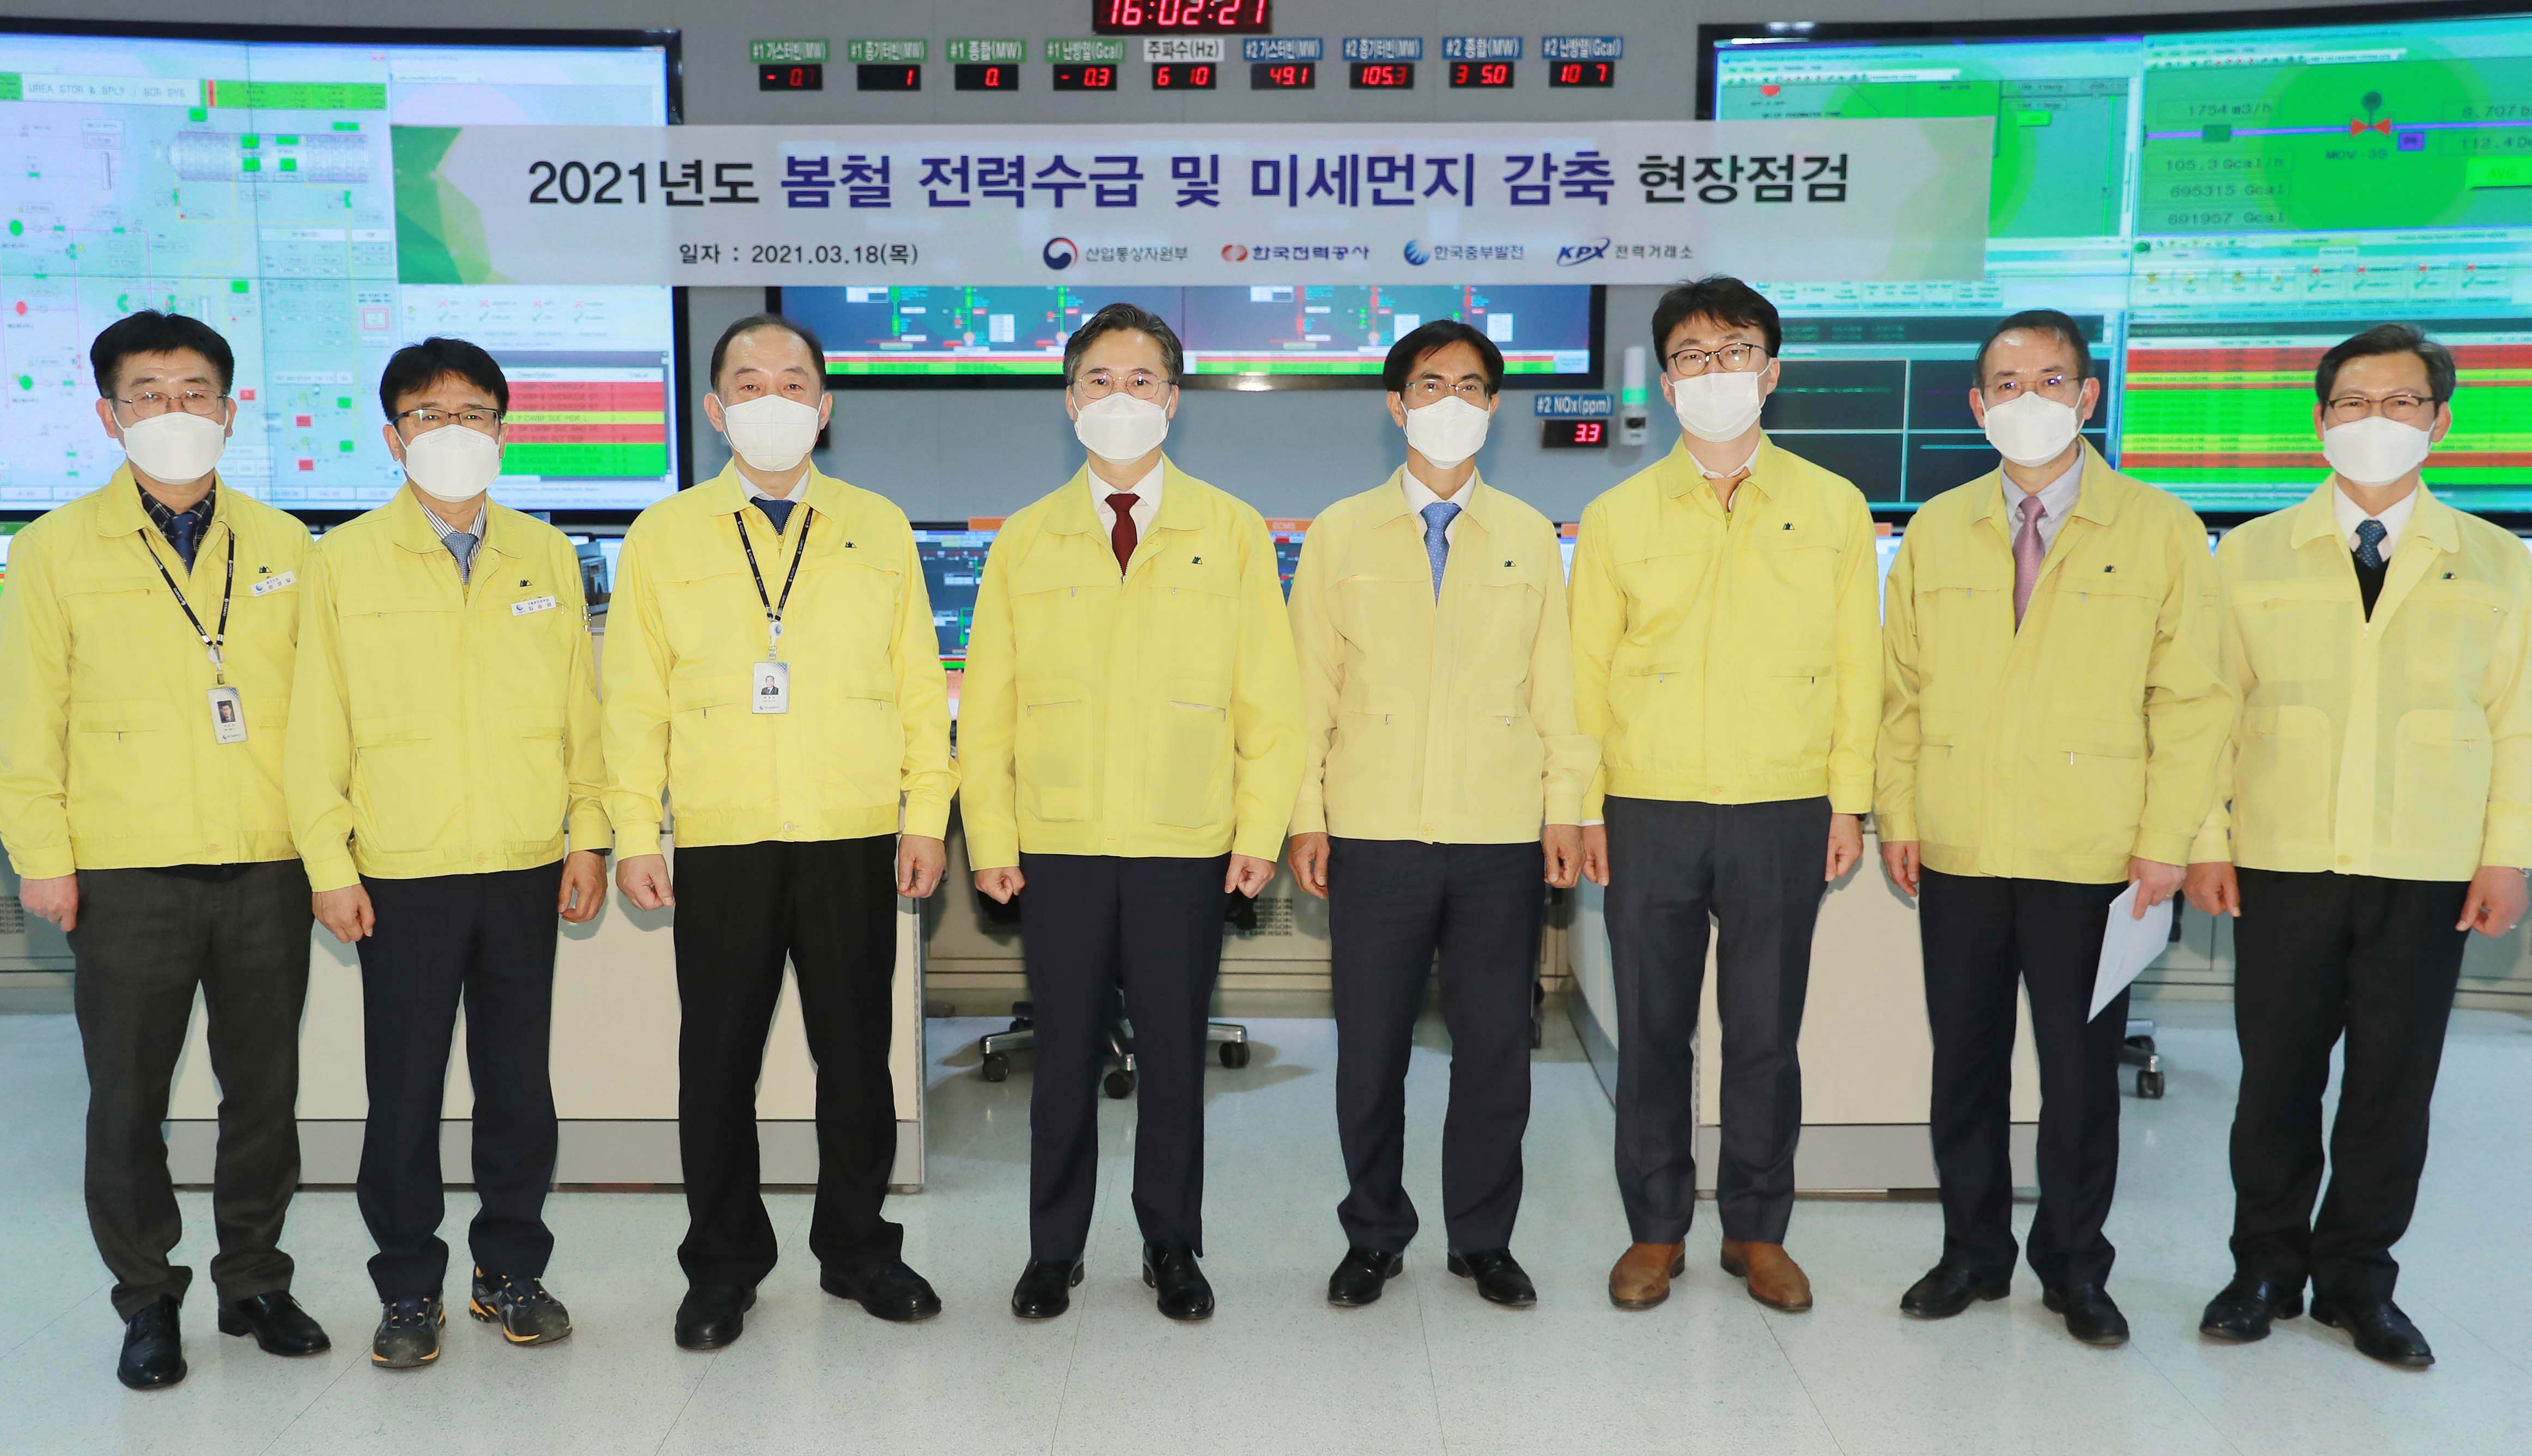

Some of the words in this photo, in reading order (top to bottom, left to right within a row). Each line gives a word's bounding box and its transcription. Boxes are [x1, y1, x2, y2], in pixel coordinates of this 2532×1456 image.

[752, 43, 764, 59] #1
[851, 43, 862, 59] #1
[950, 42, 964, 59] #1
[1047, 42, 1060, 58] #1
[1148, 40, 1220, 59] 주파수(Hz)
[1245, 41, 1257, 58] #2
[1345, 40, 1357, 57] #2
[1446, 38, 1462, 57] #2
[1544, 39, 1558, 56] #2
[528, 160, 759, 206] 2021년도
[781, 155, 891, 208] 봄철
[918, 154, 1144, 208] 전력수급
[1171, 154, 1220, 208] 및
[1251, 153, 1474, 208] 미세먼지
[1504, 150, 1614, 206] 감축
[1638, 153, 1848, 204] 현장점검
[679, 244, 721, 264] 일자
[752, 245, 918, 266] 2021.03.18(목)
[1085, 246, 1188, 263] 산업통상자원부
[1252, 245, 1370, 261] 한국전력공사
[1433, 245, 1524, 261] 한국중부발전
[1558, 241, 1608, 260] KPX
[1615, 244, 1694, 260] 전력거래소
[1537, 397, 1551, 413] #2
[1554, 395, 1612, 415] NOx(ppm)
